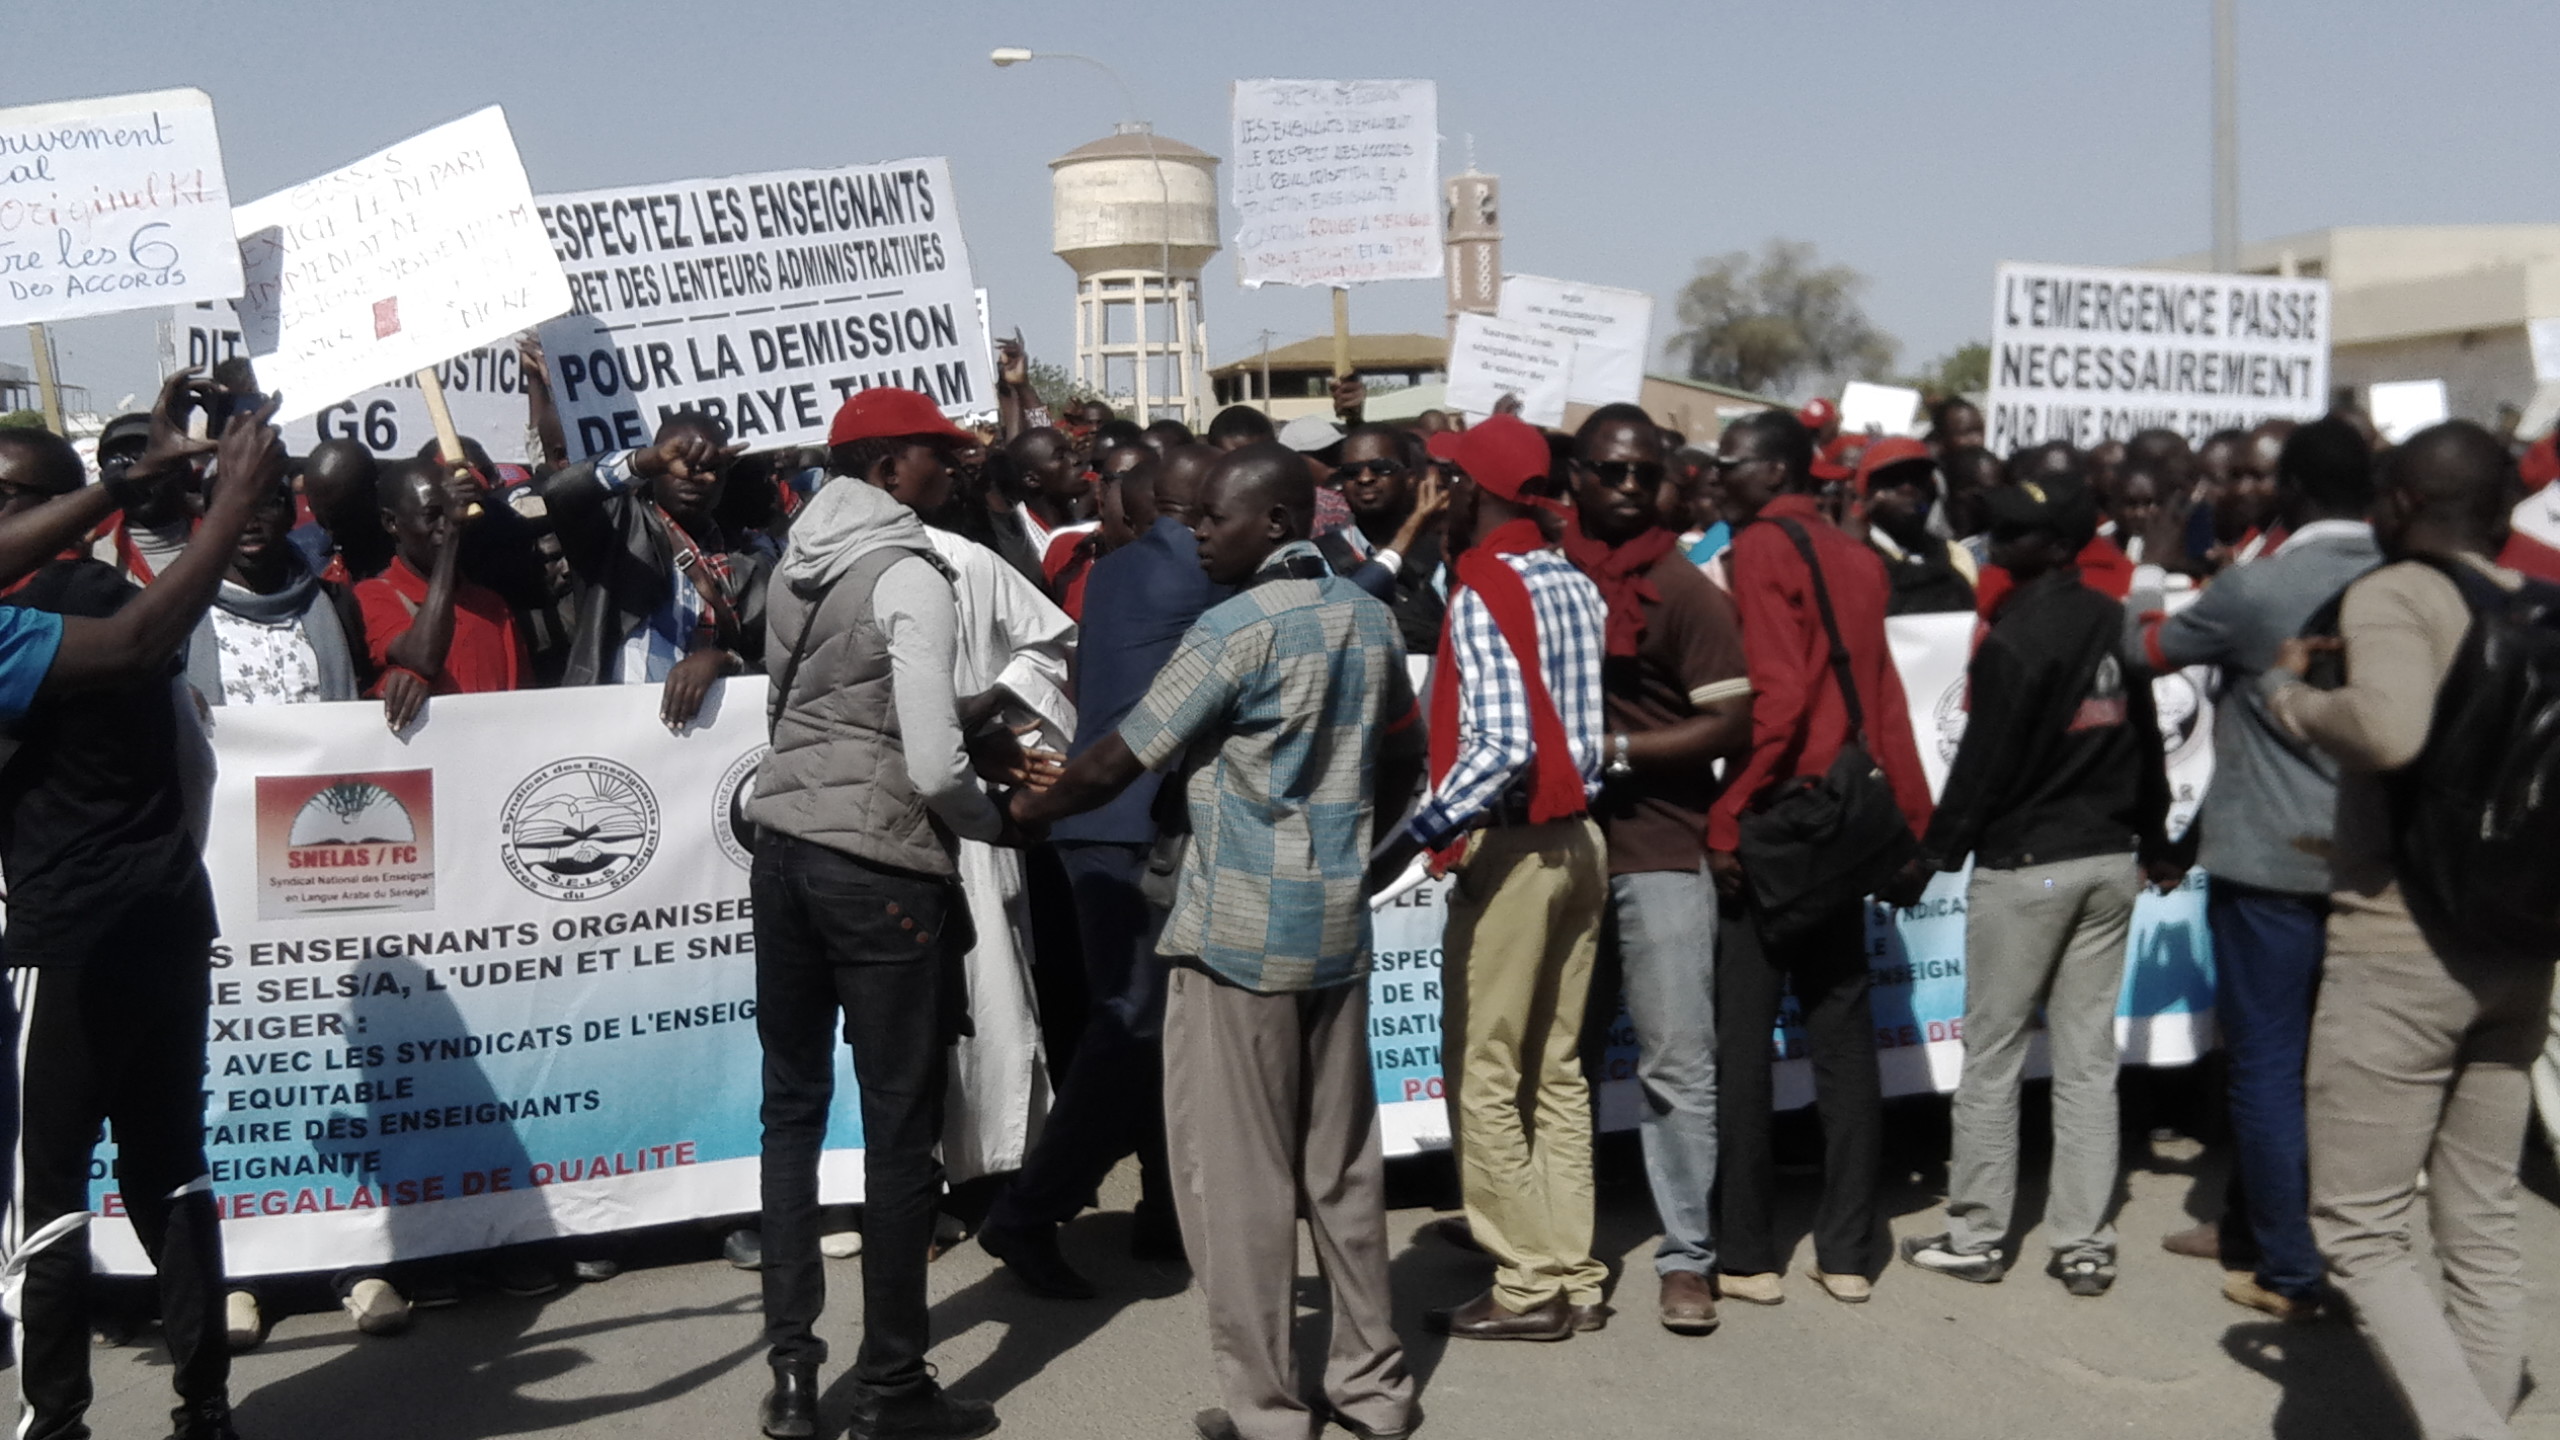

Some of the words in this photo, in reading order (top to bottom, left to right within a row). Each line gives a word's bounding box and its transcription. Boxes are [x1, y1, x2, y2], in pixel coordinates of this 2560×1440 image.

[691, 186, 748, 246] LES
[749, 168, 936, 240] ENSEIGNANTS
[58, 228, 117, 269] les
[130, 222, 179, 271] 6
[562, 269, 612, 318] RET
[618, 264, 661, 310] DES
[661, 249, 773, 303] LENTEURS
[776, 231, 947, 291] ADMINISTRATIVES
[2005, 276, 2218, 336] L'EMERGENCE
[2228, 286, 2317, 340] PASSE
[558, 341, 683, 402] POUR
[688, 333, 745, 383] LA
[749, 303, 960, 374] DEMISSION
[2000, 343, 2312, 398] NECESSAIREMENT
[578, 409, 647, 458] DE
[502, 772, 549, 835] Syndicat
[552, 761, 582, 775] des
[588, 761, 658, 826] Enseignants
[288, 848, 370, 869] SNELAS
[392, 845, 418, 865] FC
[717, 821, 733, 843] DES
[317, 874, 359, 886] National
[501, 842, 539, 890] Libres
[563, 890, 584, 900] du
[302, 891, 338, 904] Langue
[250, 922, 539, 967] ENSEIGNANTS
[256, 972, 411, 1004] SELS/A,
[426, 955, 563, 993] L'UDEN
[577, 948, 622, 975] ET
[633, 941, 676, 967] LE
[686, 932, 755, 961] SNE
[1382, 983, 1414, 1004] DE
[223, 1051, 313, 1077] AVEC
[325, 1044, 386, 1071] LES
[396, 1025, 573, 1064] SYNDICATS
[584, 1018, 621, 1043] DE
[1927, 1019, 1964, 1042] DE
[227, 1077, 414, 1112] EQUITABLE
[305, 1116, 368, 1142] DES
[379, 1090, 600, 1136] ENSEIGNANTS
[462, 1168, 512, 1196] DE
[529, 1141, 697, 1187] QUALITE
